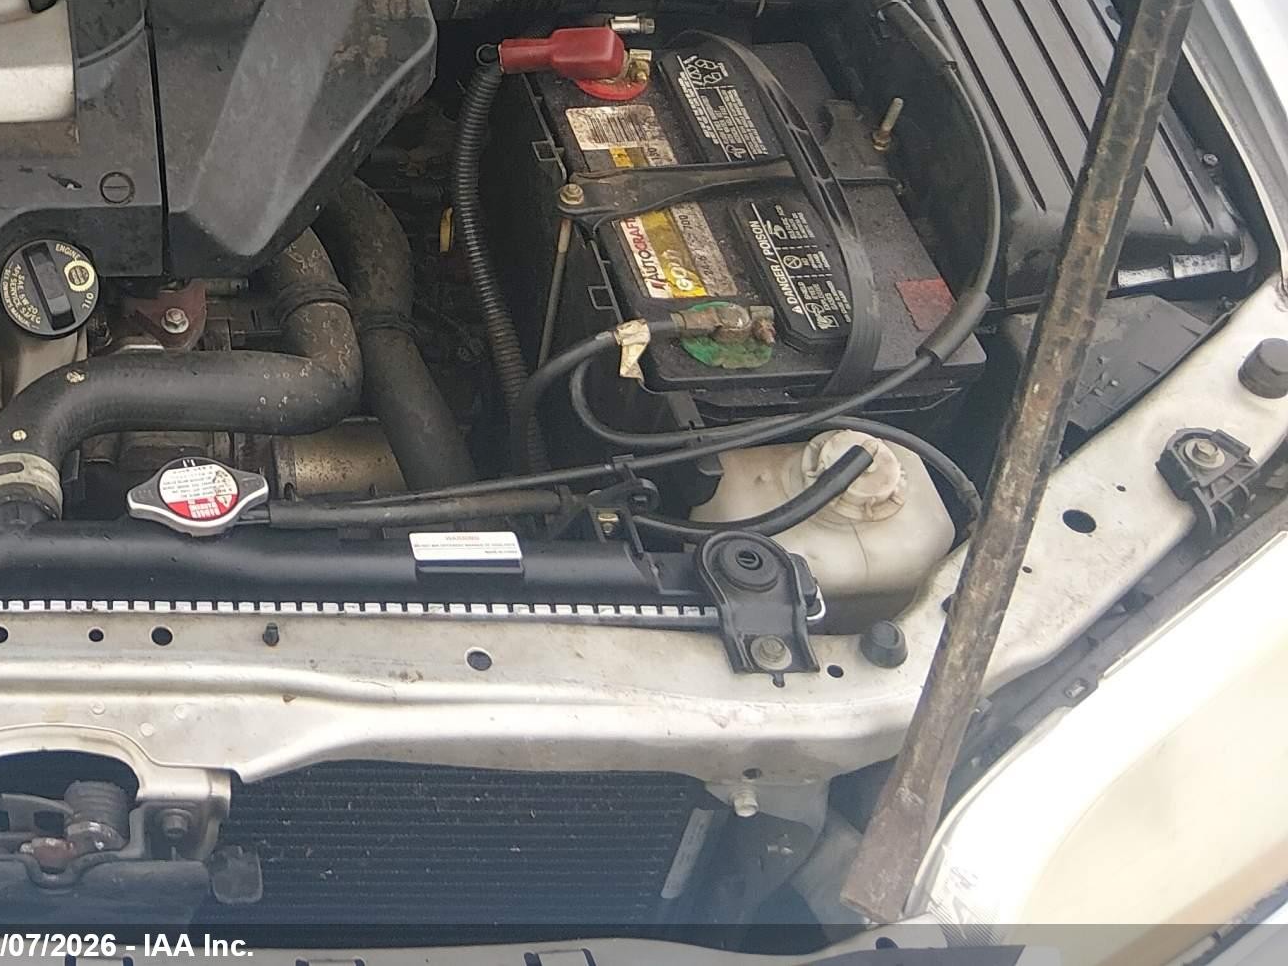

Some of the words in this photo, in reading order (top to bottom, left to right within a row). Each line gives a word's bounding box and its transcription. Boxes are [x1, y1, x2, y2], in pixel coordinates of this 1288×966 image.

[748, 220, 774, 255] POISON
[82, 292, 94, 309] OIL
[770, 264, 798, 303] DANGER
